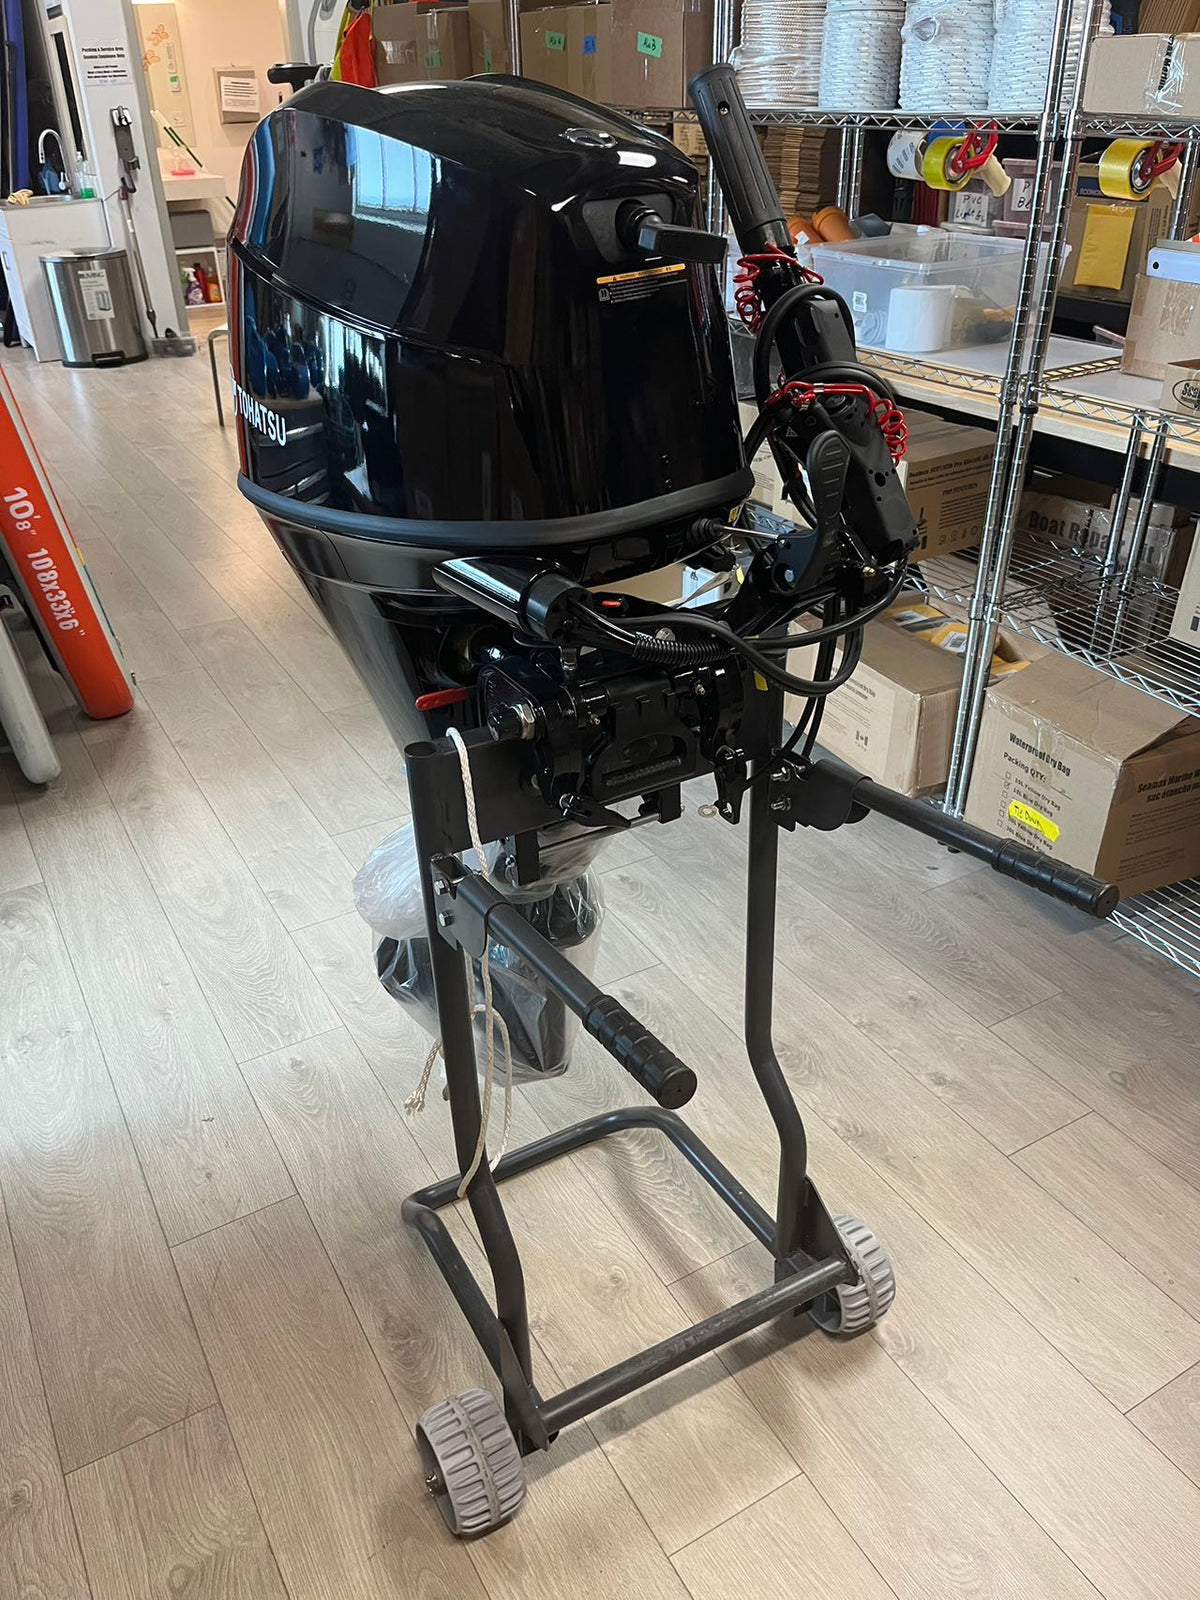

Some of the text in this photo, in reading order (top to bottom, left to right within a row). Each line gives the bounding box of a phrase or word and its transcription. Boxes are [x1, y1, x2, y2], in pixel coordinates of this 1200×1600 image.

[237, 384, 287, 446] TOHATSU
[1028, 510, 1066, 538] Boat
[1069, 522, 1126, 550] Repar
[1003, 752, 1030, 774] Packing
[1030, 768, 1047, 783] QTY:
[1009, 732, 1072, 777] Waterproof Dry Bag
